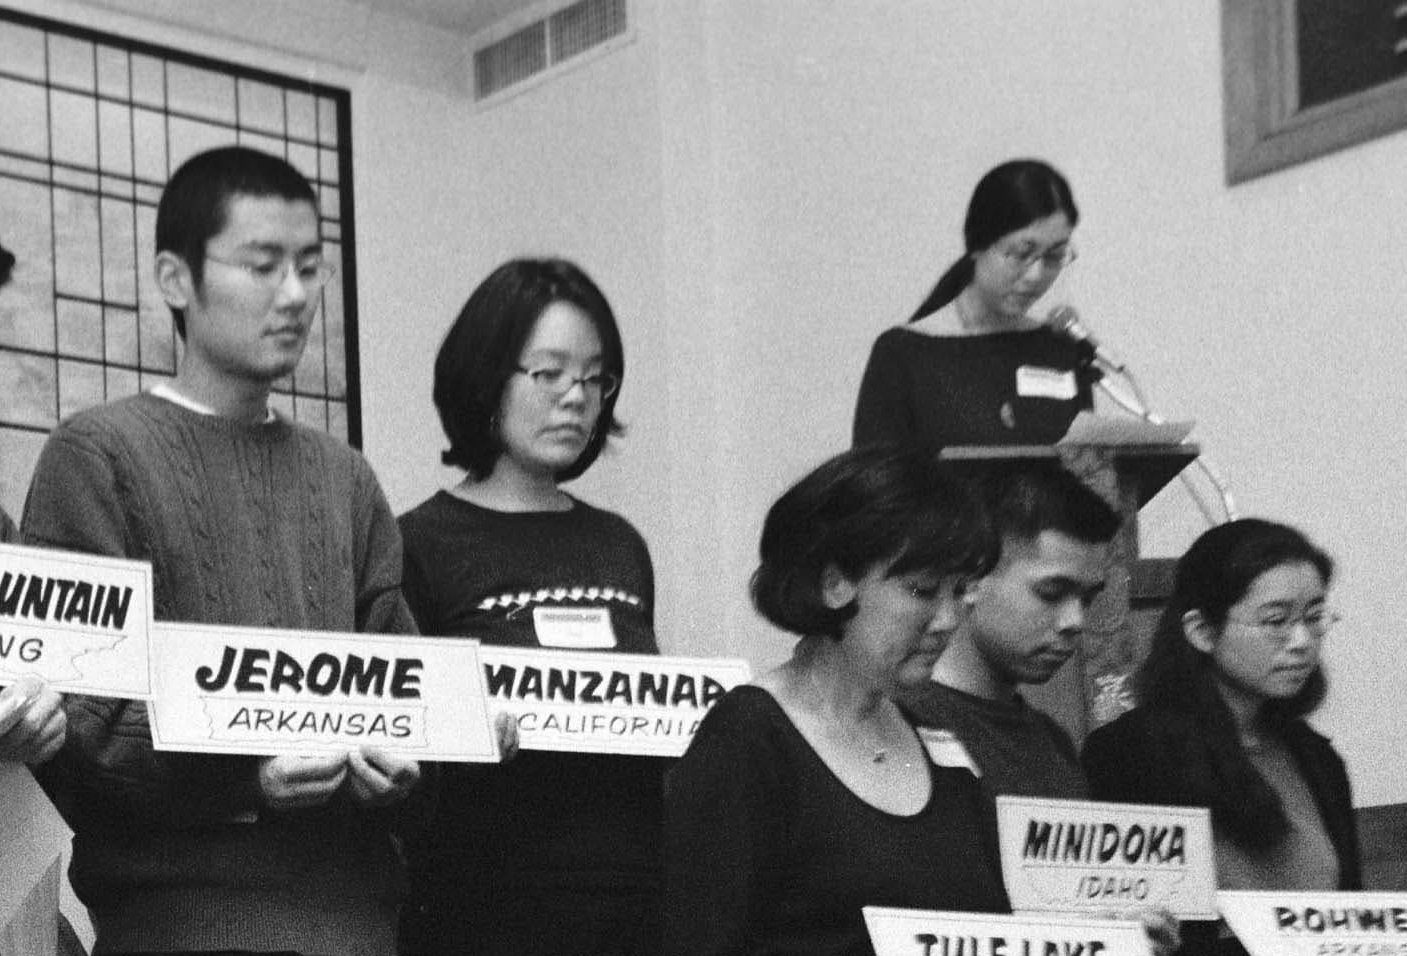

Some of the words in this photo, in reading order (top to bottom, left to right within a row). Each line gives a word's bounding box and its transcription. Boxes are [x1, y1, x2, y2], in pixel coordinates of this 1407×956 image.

[195, 646, 424, 698] JEROME
[227, 707, 412, 739] ARKANSAS
[1022, 820, 1187, 863] MINIDOKA
[1076, 876, 1149, 900] IDAHO
